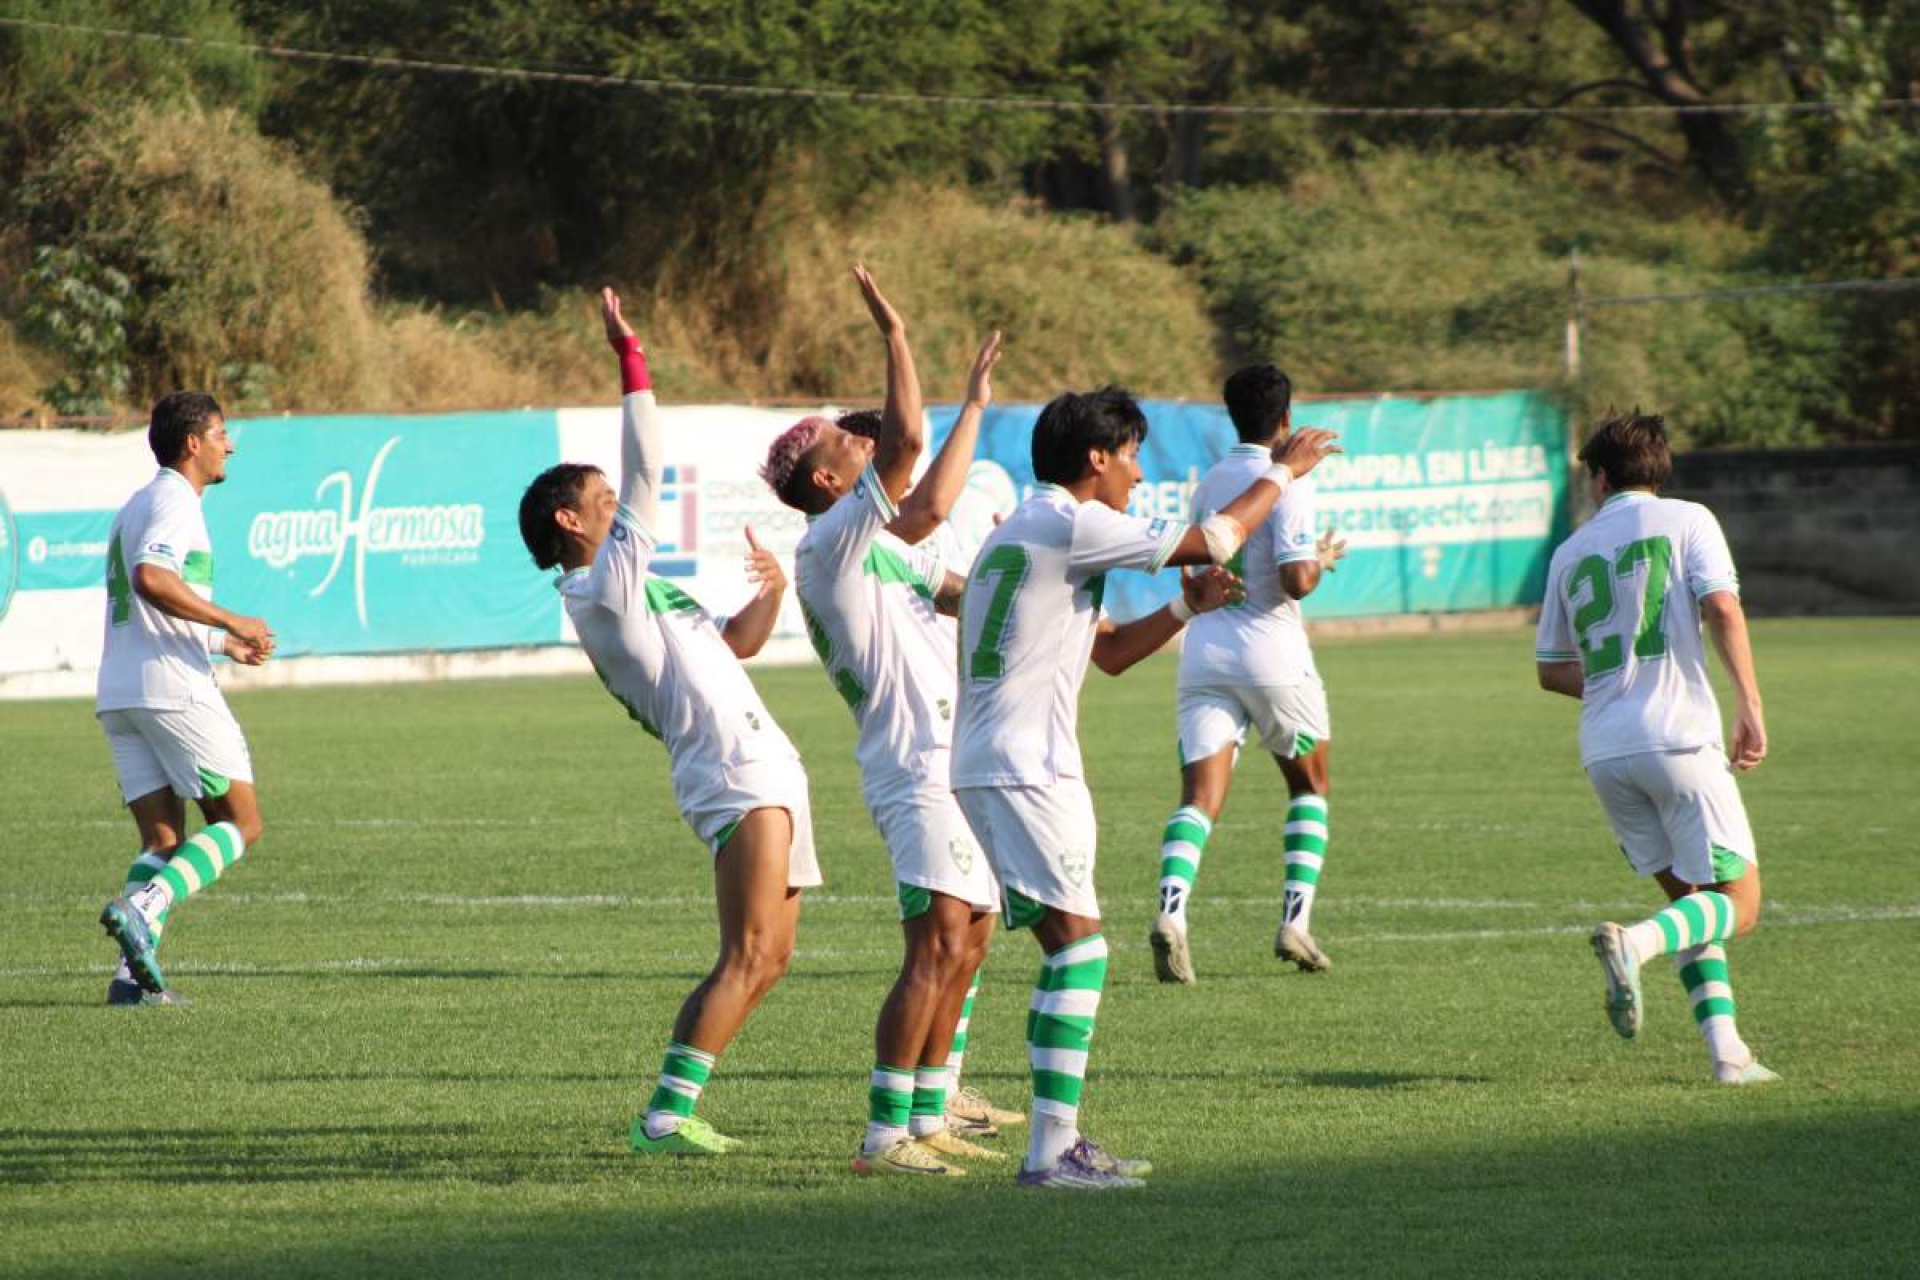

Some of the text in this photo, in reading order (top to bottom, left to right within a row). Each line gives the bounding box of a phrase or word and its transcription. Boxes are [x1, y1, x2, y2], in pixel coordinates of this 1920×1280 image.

[1425, 450, 1465, 484] EN
[970, 542, 1030, 684] 7
[1567, 534, 1673, 681] 27
